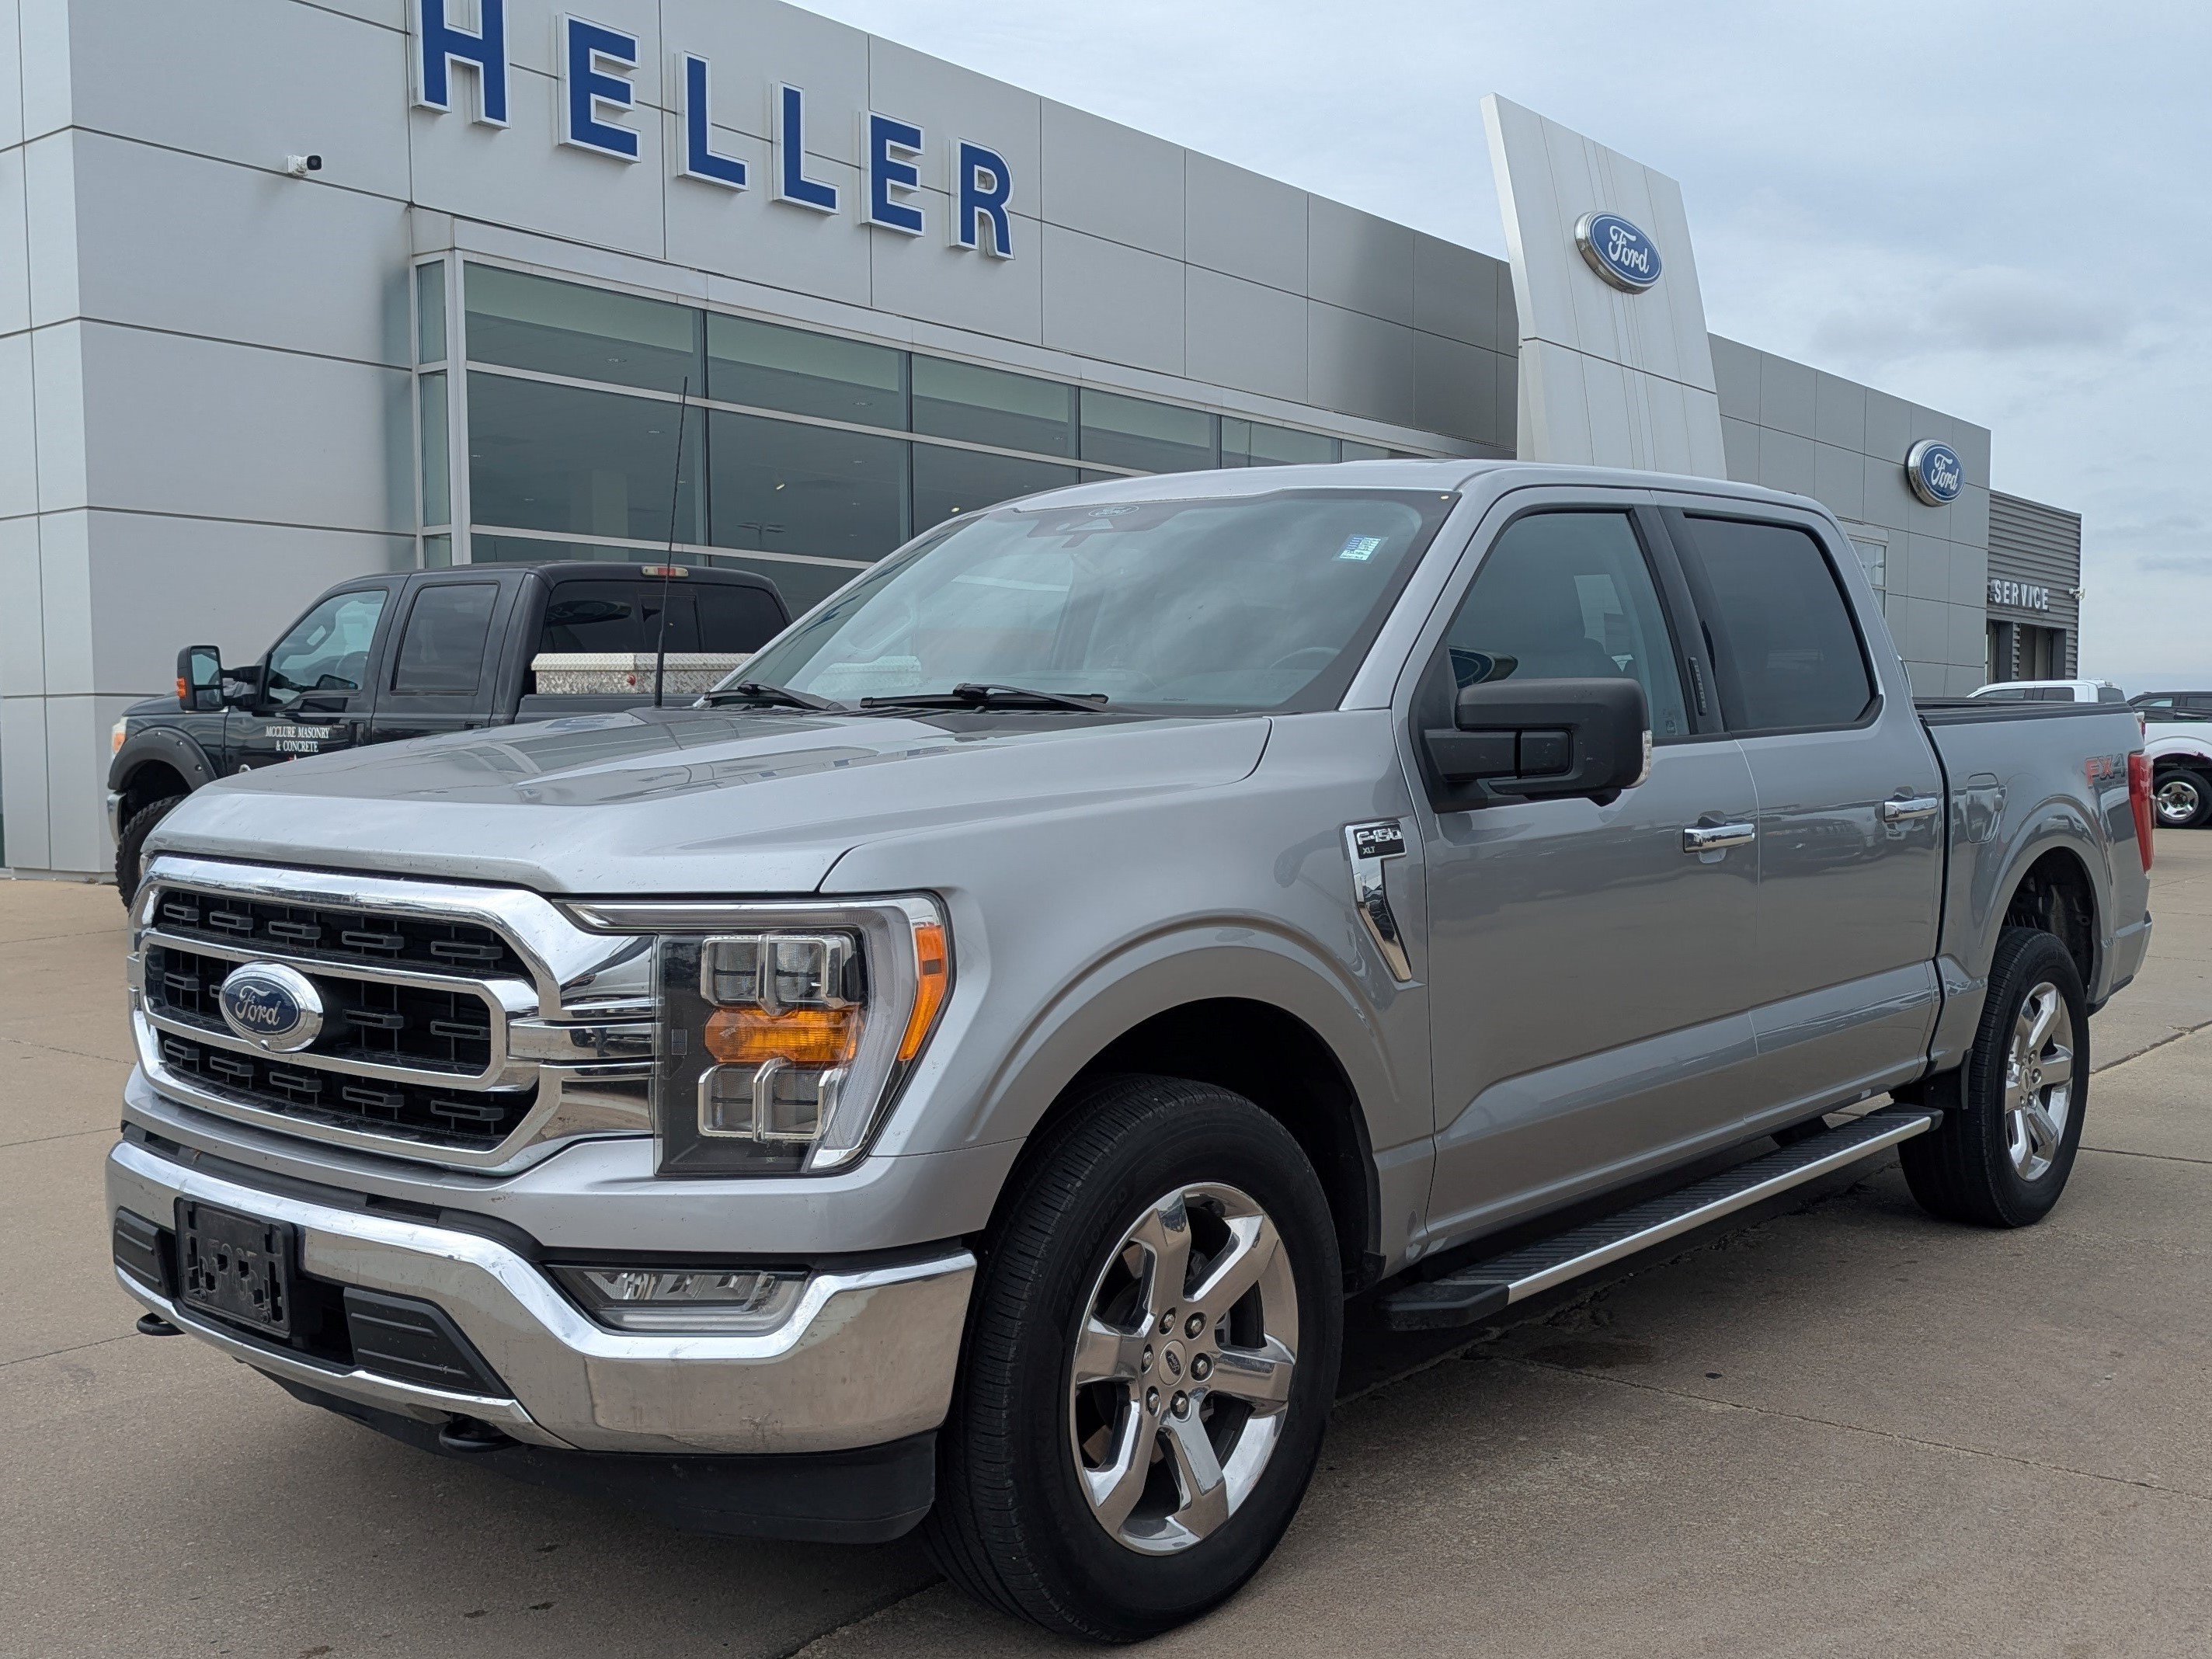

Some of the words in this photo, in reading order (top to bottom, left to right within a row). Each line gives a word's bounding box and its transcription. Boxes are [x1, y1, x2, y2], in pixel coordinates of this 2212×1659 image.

[414, 0, 1015, 259] HELLER
[1608, 225, 1649, 273] Ford
[1930, 454, 1960, 490] Ford
[1993, 579, 2050, 610] SERVICE
[276, 740, 281, 751] &
[283, 740, 319, 753] CONCRETE
[297, 726, 330, 739] MASONRY
[1356, 827, 1403, 845] F-150
[1362, 846, 1376, 855] XLT
[235, 985, 282, 1026] Ford
